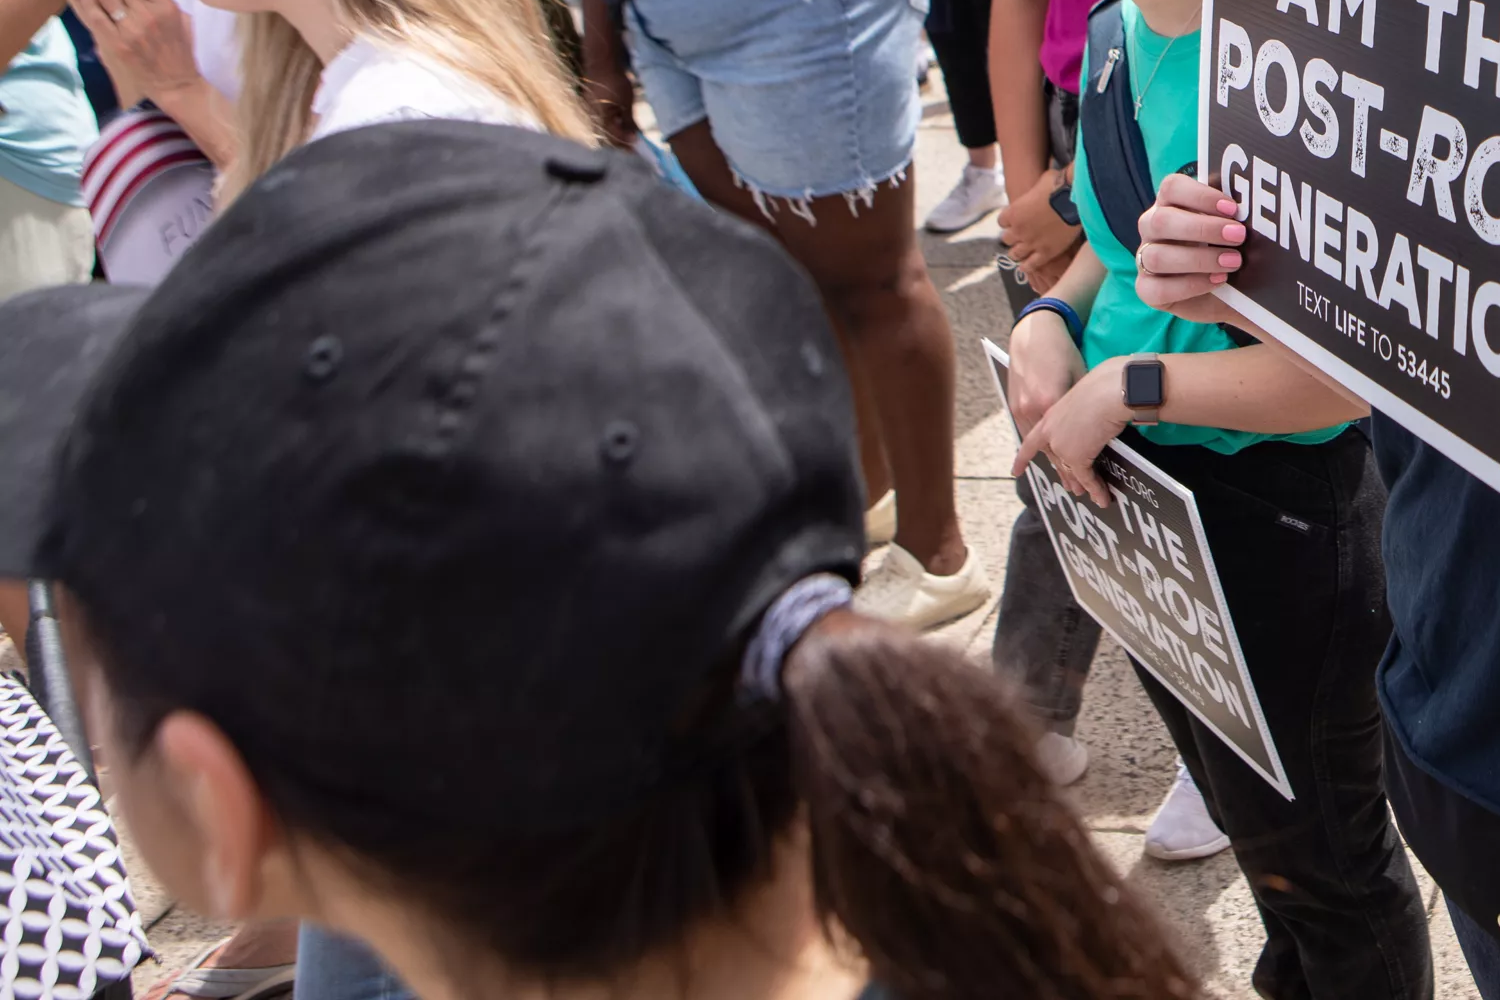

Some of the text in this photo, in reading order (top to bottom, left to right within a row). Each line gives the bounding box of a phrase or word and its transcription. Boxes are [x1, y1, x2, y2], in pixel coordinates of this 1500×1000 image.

[1296, 280, 1451, 400] TEXT LIFE TO 53445
[1029, 459, 1229, 665] POST-ROE
[1107, 482, 1196, 583] THE
[1058, 532, 1252, 730] GENERATION
